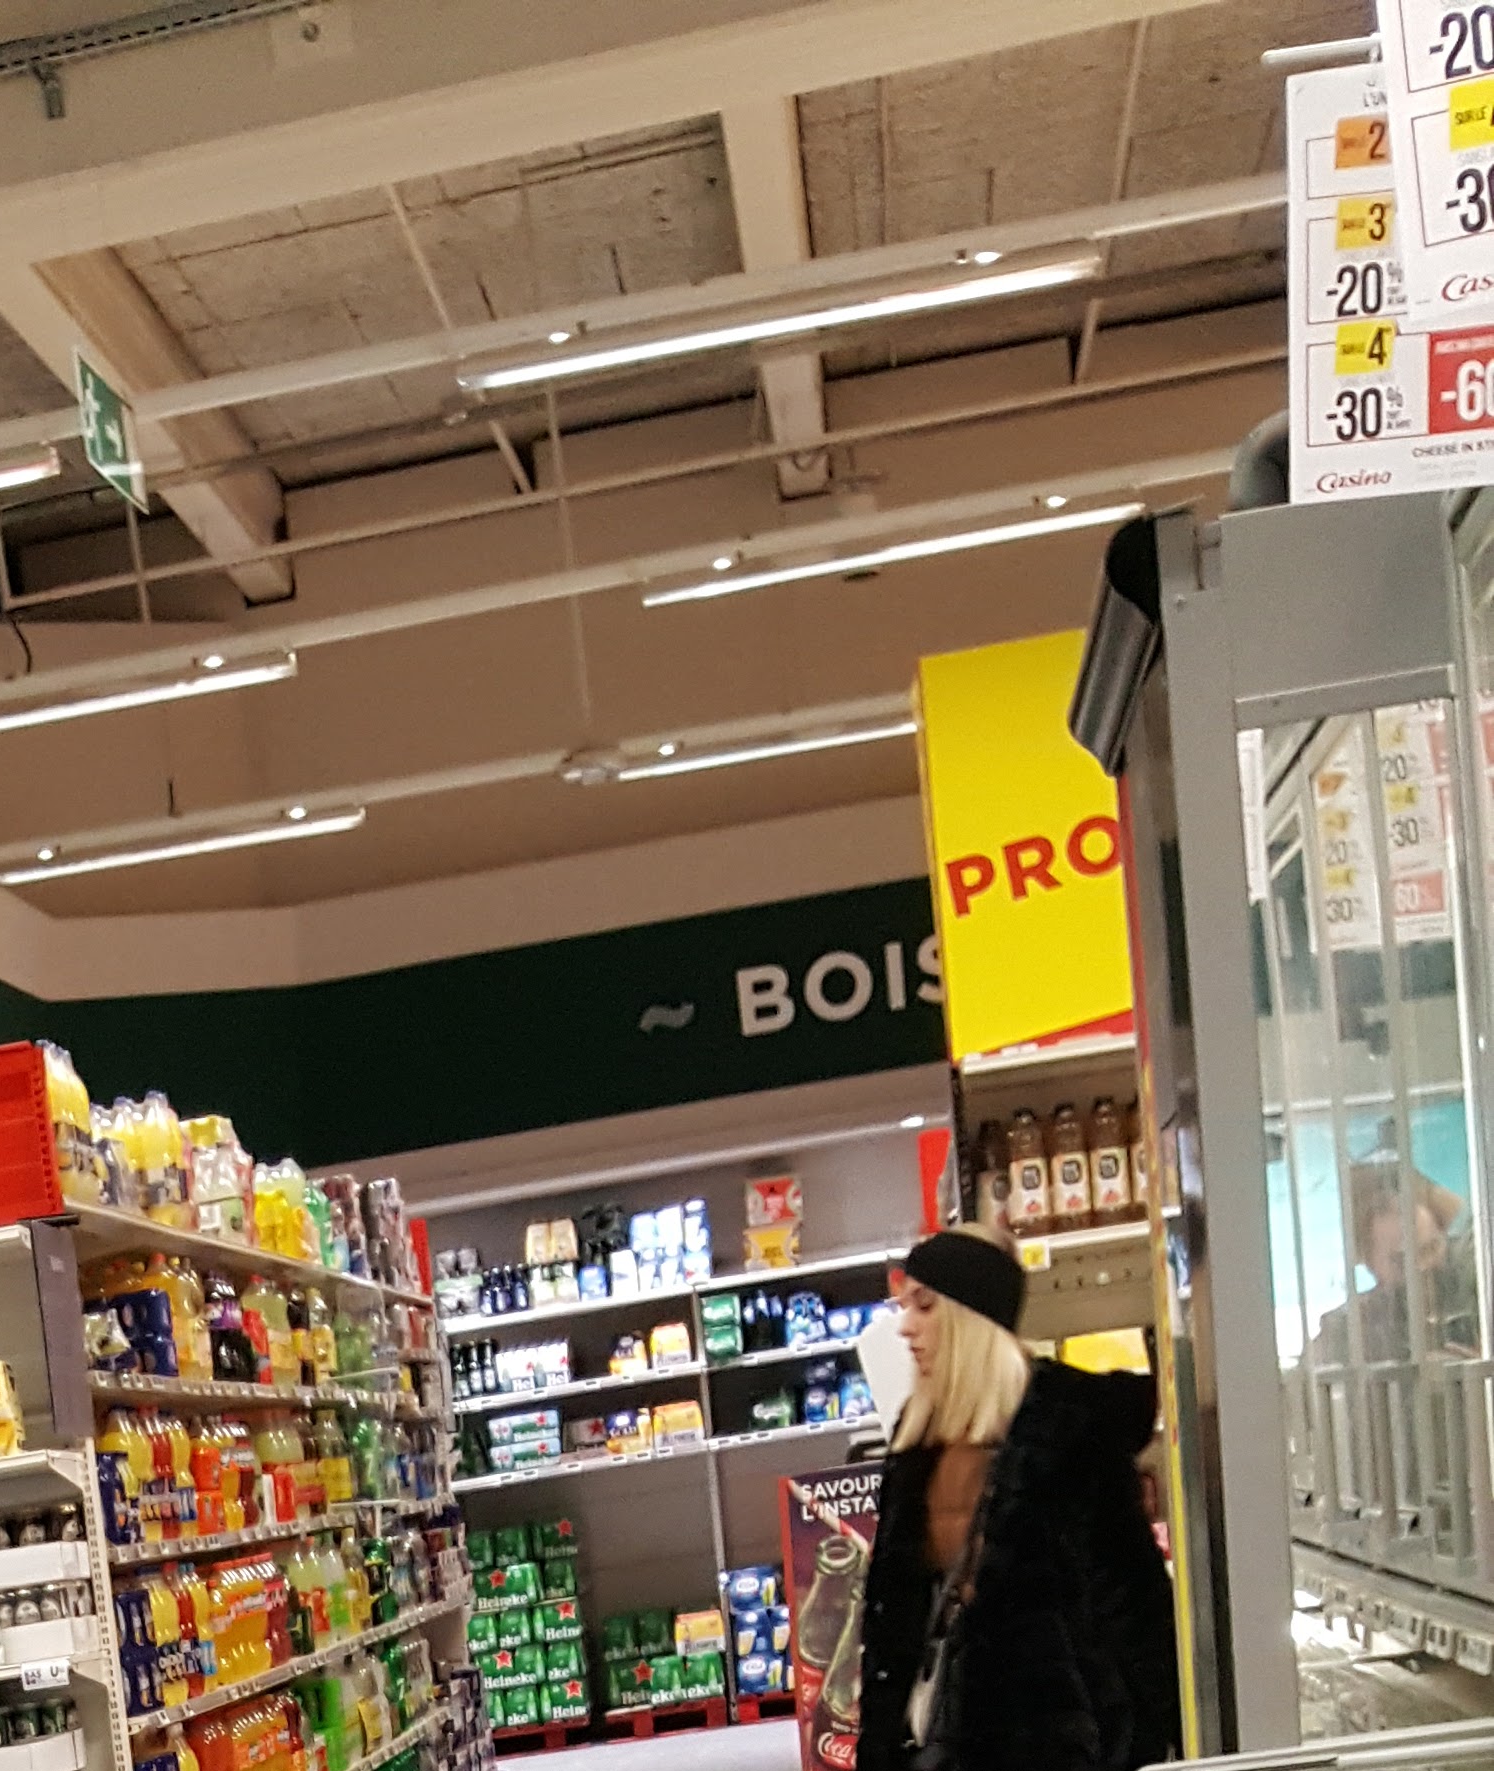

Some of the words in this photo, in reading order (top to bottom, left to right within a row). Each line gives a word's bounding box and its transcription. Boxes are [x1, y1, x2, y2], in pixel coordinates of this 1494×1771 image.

[1429, 5, 1494, 80] -20
[1368, 121, 1386, 160] 2
[1445, 163, 1494, 233] -3
[1368, 203, 1386, 241] 3
[1326, 262, 1383, 317] -20
[1367, 327, 1388, 365] 4
[1326, 388, 1383, 441] -30
[1316, 471, 1392, 493] Casino
[945, 815, 1121, 918] PRO
[801, 1473, 883, 1499] SAVOUR
